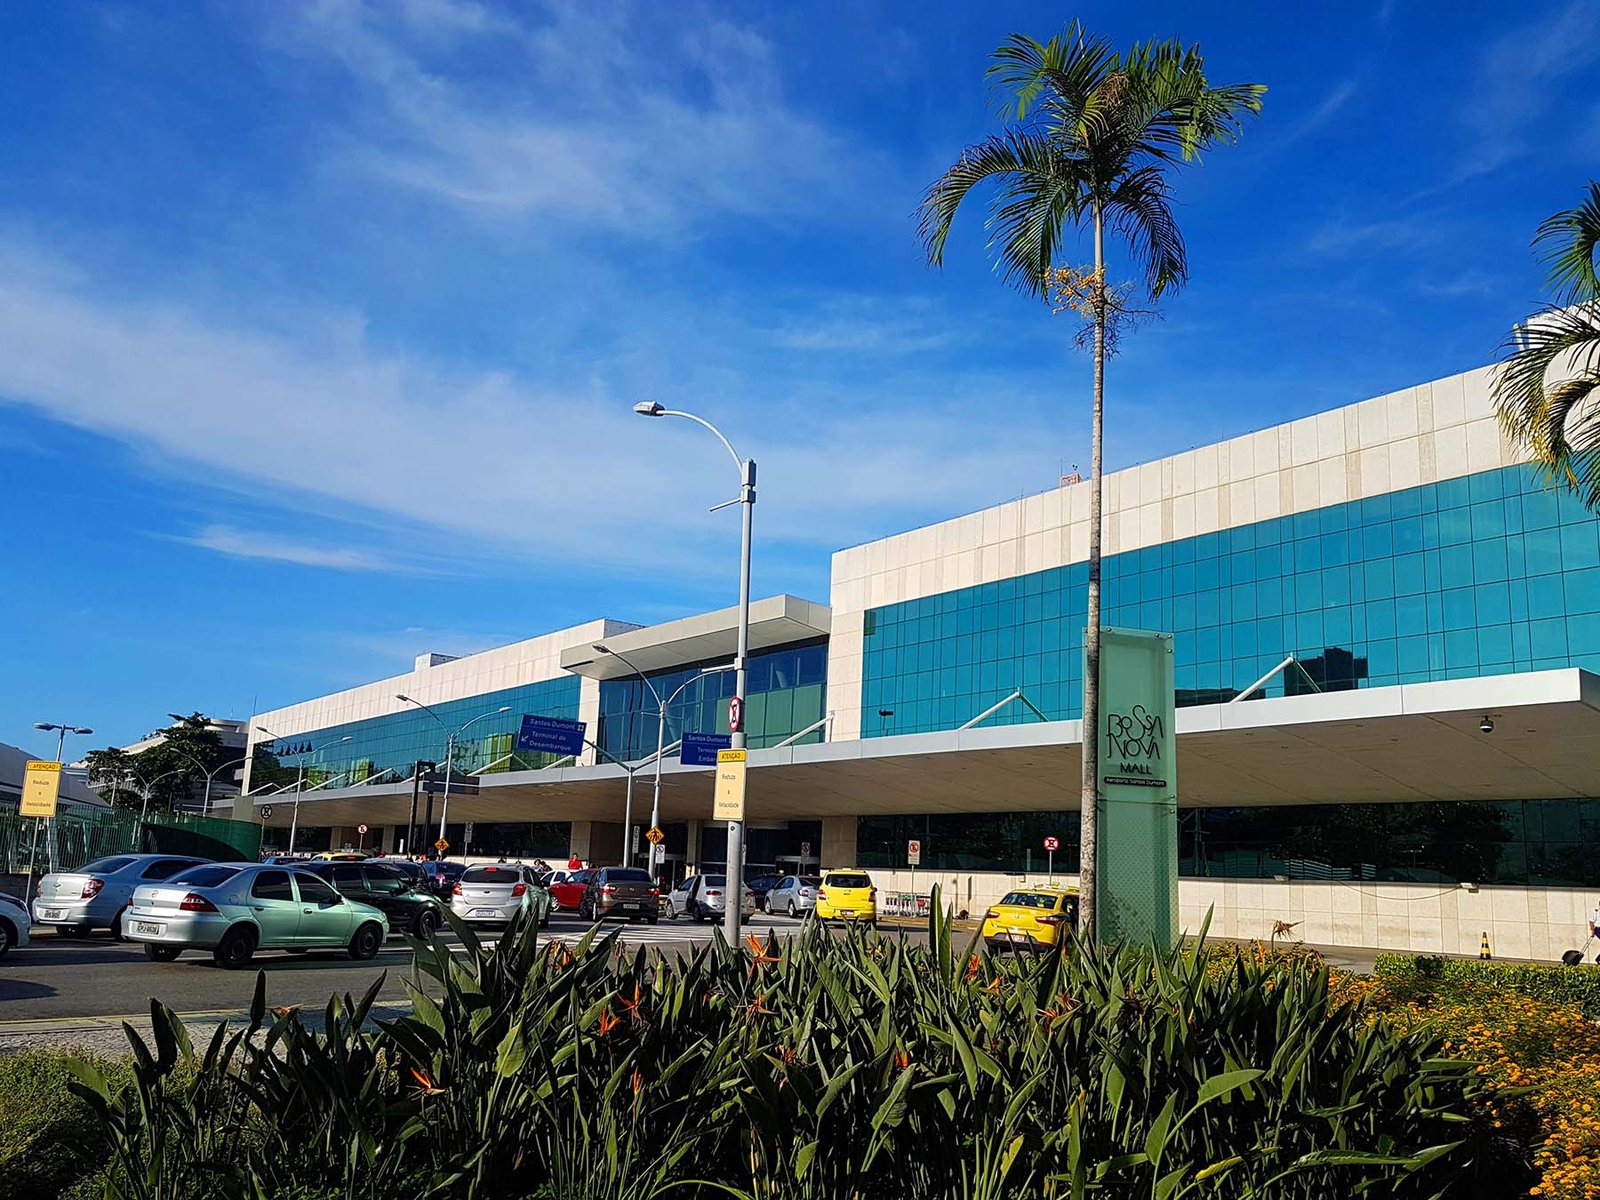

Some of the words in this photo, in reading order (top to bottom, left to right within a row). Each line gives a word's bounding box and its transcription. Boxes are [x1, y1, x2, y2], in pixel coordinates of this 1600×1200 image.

[529, 718, 551, 727] Santos
[552, 721, 576, 730] Dumont
[1107, 704, 1164, 741] BOSSA
[531, 730, 558, 739] Terminal
[688, 734, 706, 742] Santos
[529, 740, 571, 751] Desembarque
[697, 746, 717, 754] Termina
[1105, 733, 1161, 760] NOVA
[721, 751, 741, 759] ATENÇÃO
[1120, 761, 1153, 775] MALL
